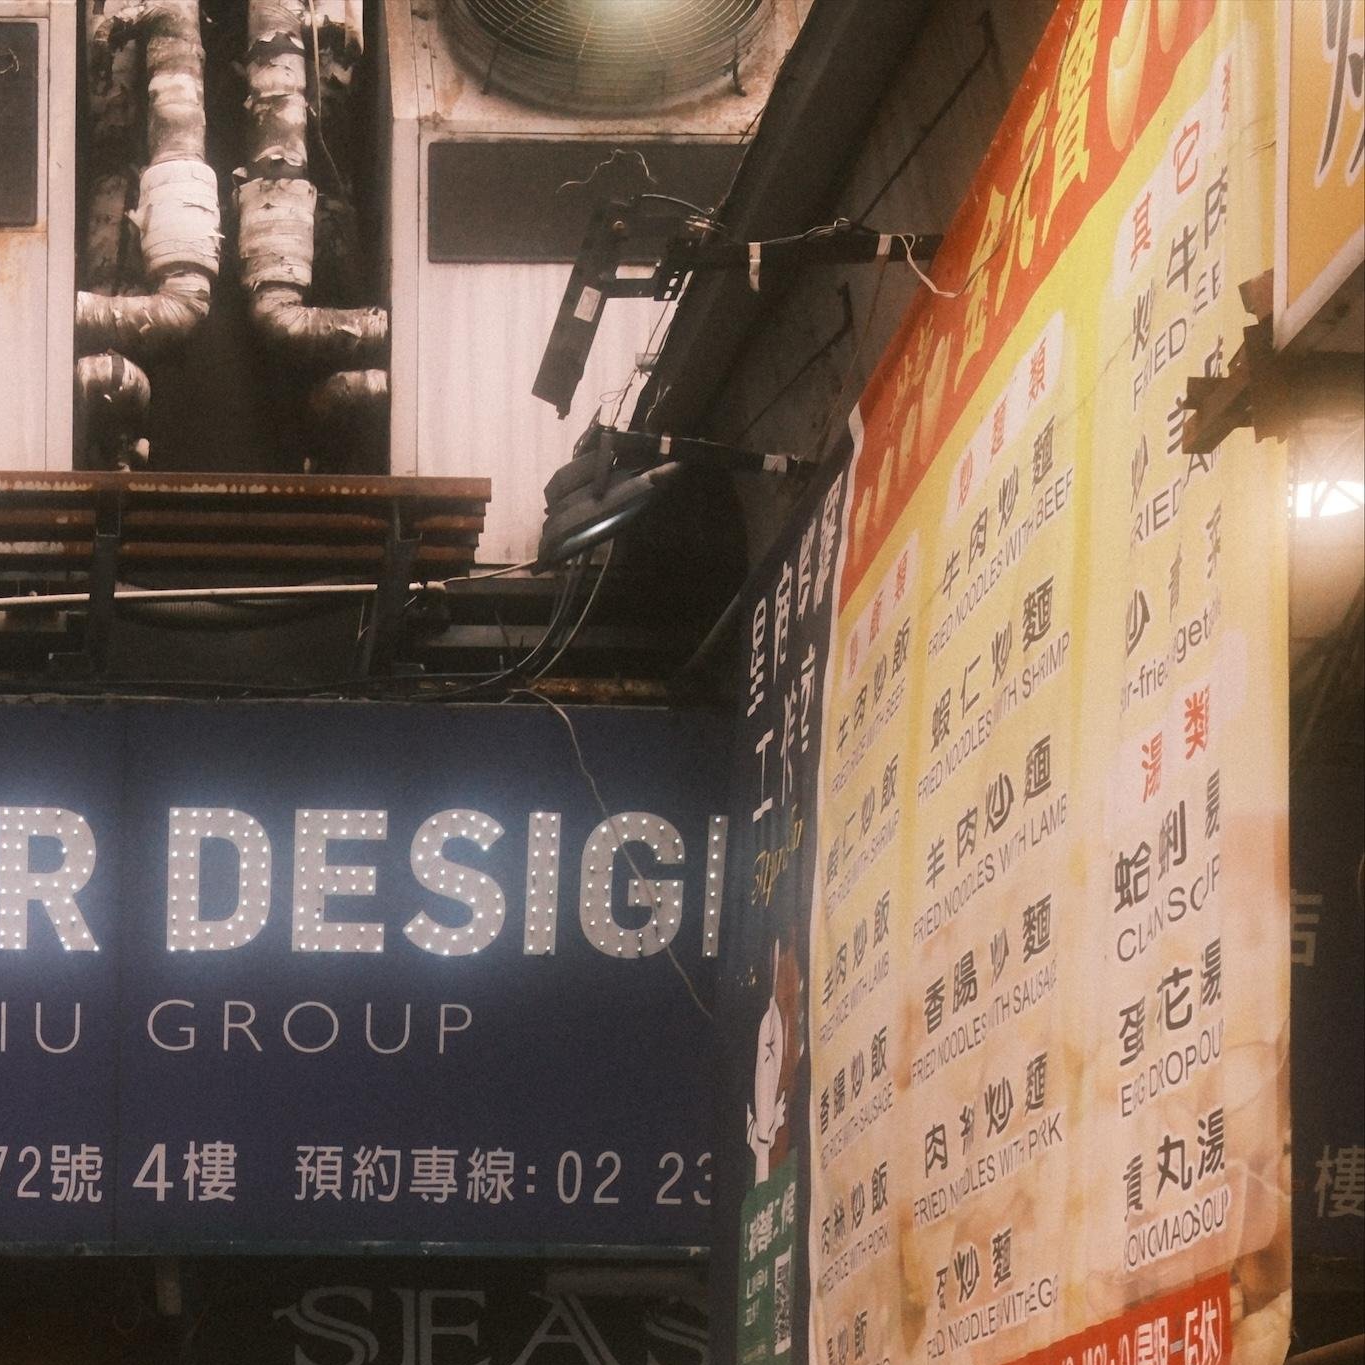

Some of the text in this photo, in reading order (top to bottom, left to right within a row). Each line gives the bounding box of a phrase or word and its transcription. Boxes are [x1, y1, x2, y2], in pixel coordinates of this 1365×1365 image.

[166, 807, 729, 959] DESIG
[147, 999, 472, 1055] GROUP
[133, 1140, 237, 1203] 4樓
[295, 1144, 537, 1203] 預約專線:
